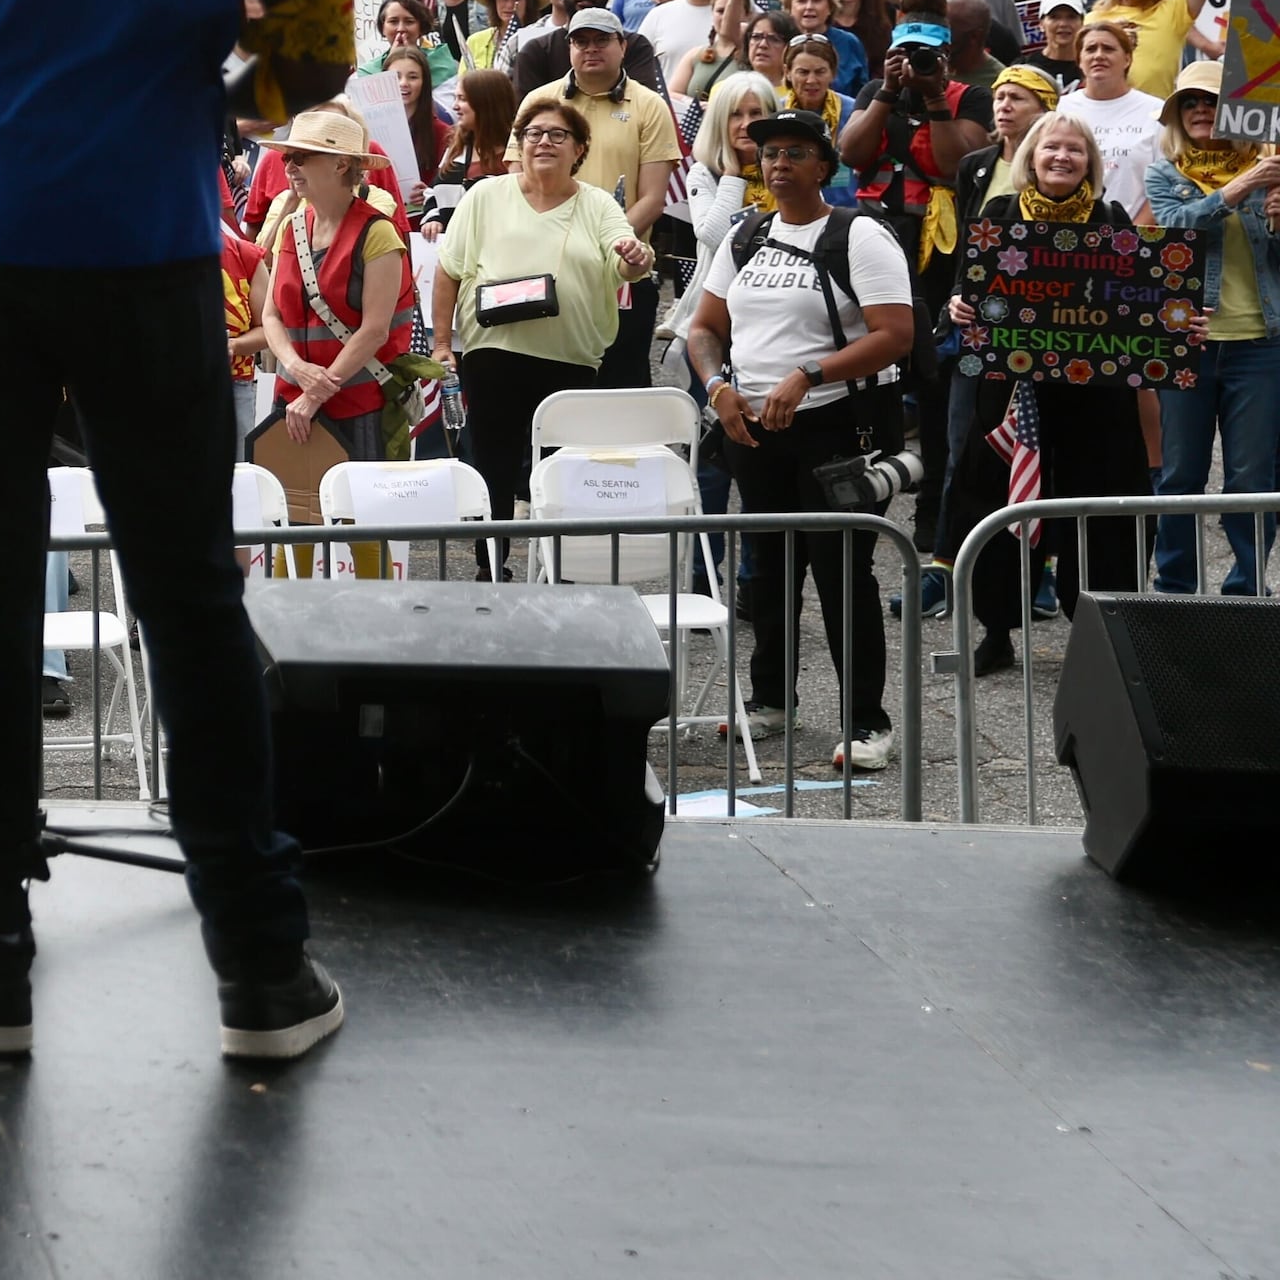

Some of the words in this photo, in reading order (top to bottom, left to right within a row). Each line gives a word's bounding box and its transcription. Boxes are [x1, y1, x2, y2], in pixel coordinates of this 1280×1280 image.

[1218, 103, 1258, 135] NO
[1117, 125, 1143, 137] you
[1112, 147, 1130, 157] for
[1027, 246, 1136, 278] Turning
[738, 271, 824, 292] ROUBLE
[988, 274, 1075, 302] Anger
[1105, 279, 1167, 302] Fear
[1052, 300, 1109, 327] into
[991, 328, 1172, 360] RESISTANCE
[391, 480, 428, 489] SEATING
[601, 480, 639, 488] SEATING
[596, 491, 627, 499] ONLY!!!
